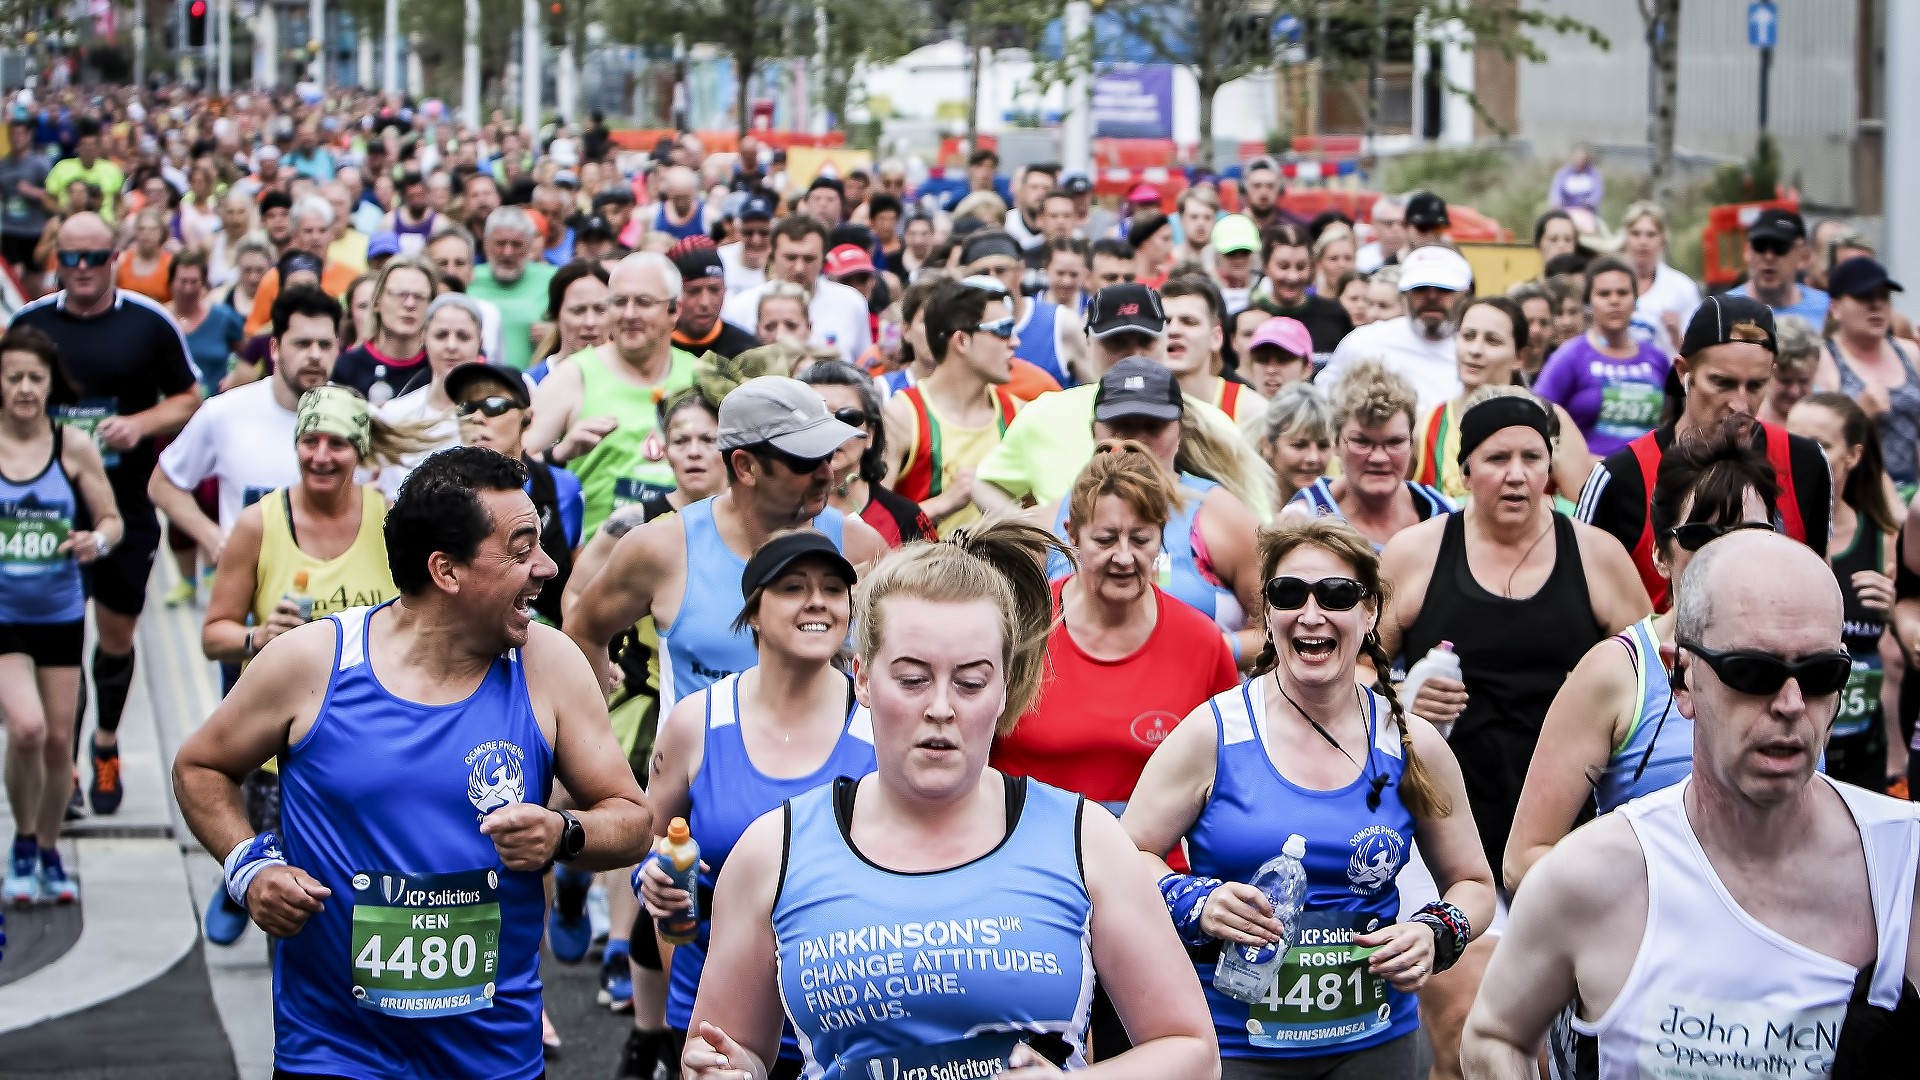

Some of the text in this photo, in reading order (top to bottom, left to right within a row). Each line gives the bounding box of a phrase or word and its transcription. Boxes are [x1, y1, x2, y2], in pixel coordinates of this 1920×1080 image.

[464, 740, 497, 765] OGMORE
[1349, 825, 1380, 847] OGMORE
[403, 889, 481, 906] JCP Solicitors
[411, 913, 449, 930] KEN
[798, 914, 1023, 967] PARKINSON'S UK
[1300, 929, 1320, 945] JCP
[355, 934, 477, 980] 4480
[483, 949, 497, 959] PEN
[484, 959, 494, 973] E
[800, 948, 1064, 991] CHANGE ATTITUDES.
[379, 993, 471, 1011] #RUNSWANSEA
[803, 971, 968, 1014] FIND A CURE.
[1260, 967, 1363, 1013] 4481
[1374, 986, 1382, 999] E
[817, 999, 912, 1034] JOIN US.
[1660, 1003, 1749, 1048] John
[1276, 1021, 1366, 1041] #RUNSWANSEA
[902, 1056, 1003, 1080] JCP Solicitors
[1656, 1037, 1797, 1079] Opportunity
